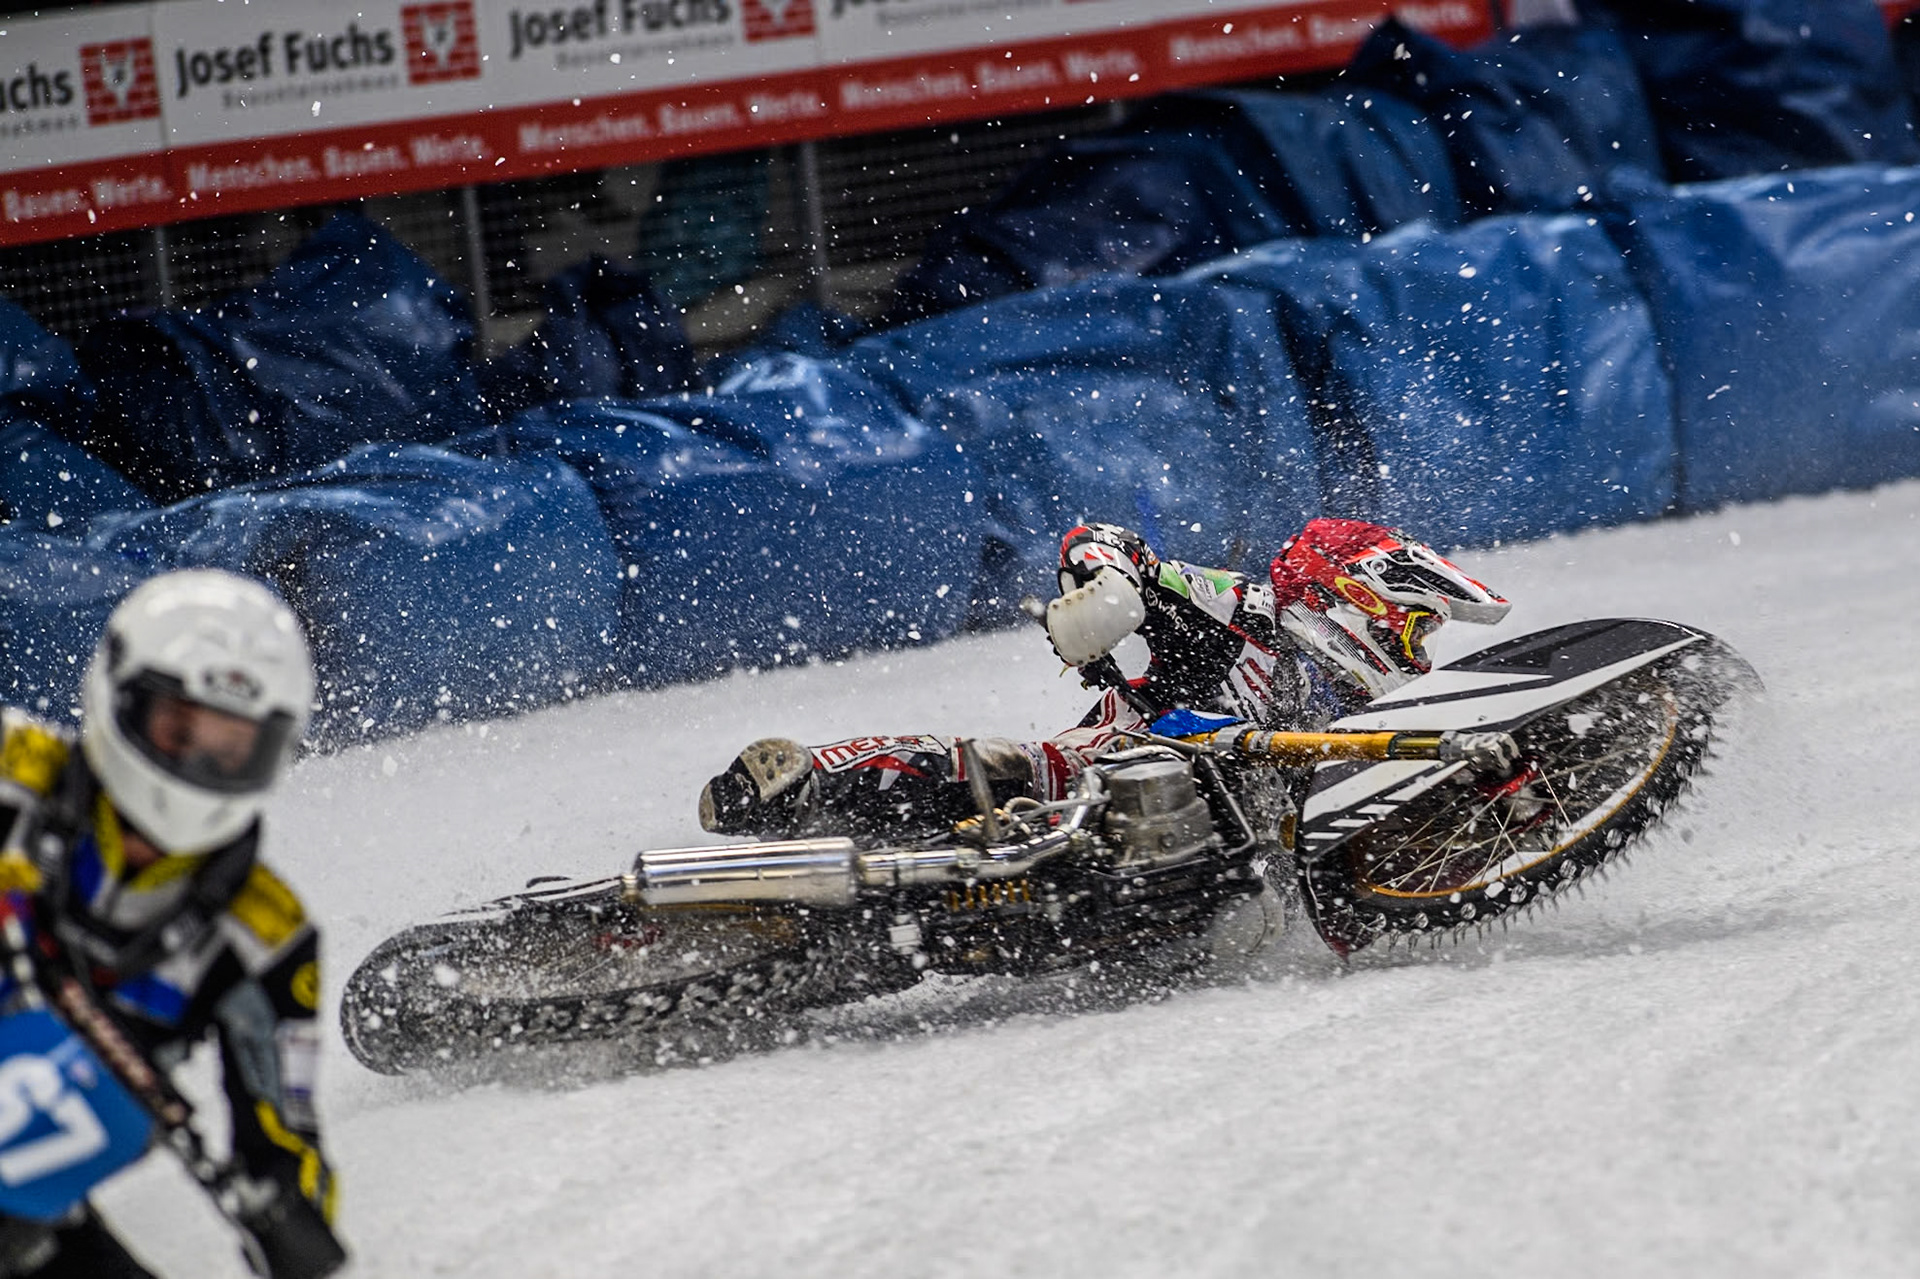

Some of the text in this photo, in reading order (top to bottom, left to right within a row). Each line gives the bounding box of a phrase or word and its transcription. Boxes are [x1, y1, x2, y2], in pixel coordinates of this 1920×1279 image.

[175, 21, 395, 97] Josef Fuchs
[509, 0, 608, 59] Josef
[0, 61, 73, 112] chs
